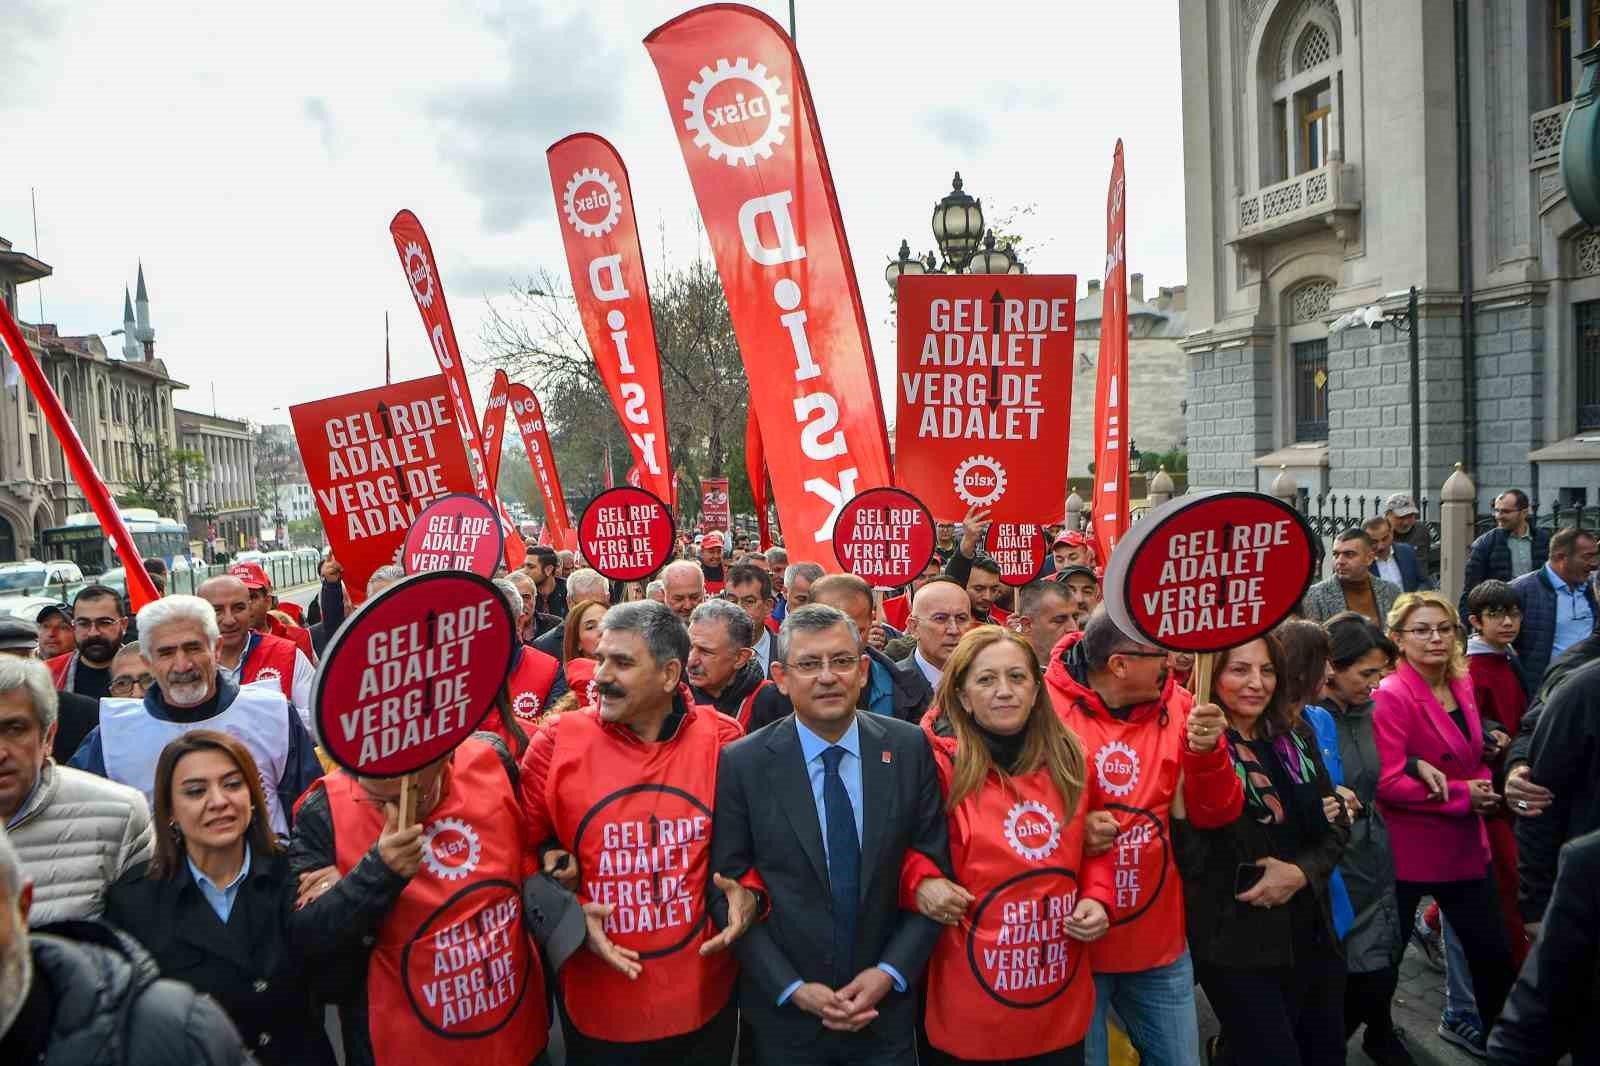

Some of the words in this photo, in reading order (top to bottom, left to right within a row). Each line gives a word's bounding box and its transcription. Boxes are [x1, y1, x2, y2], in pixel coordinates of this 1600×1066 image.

[920, 333, 1047, 366] ADALET
[918, 407, 1045, 440] ADALET
[329, 429, 436, 481] ADALET
[421, 533, 480, 552] ADALET
[596, 520, 651, 538] ADALET
[852, 525, 911, 541] ADALET
[997, 536, 1032, 549] ADALET
[599, 551, 654, 569] ADALET
[852, 560, 912, 576] ADALET
[1159, 548, 1270, 586] ADALET
[1158, 601, 1266, 638] ADALET
[358, 635, 475, 702] ADALET
[357, 698, 473, 767] ADALET
[599, 843, 691, 877] ADALET
[604, 896, 693, 934] ADALET
[997, 918, 1062, 946] ADALE
[434, 927, 511, 976] ADALET
[993, 960, 1068, 992] ADALET
[442, 972, 517, 1029] ADALET
